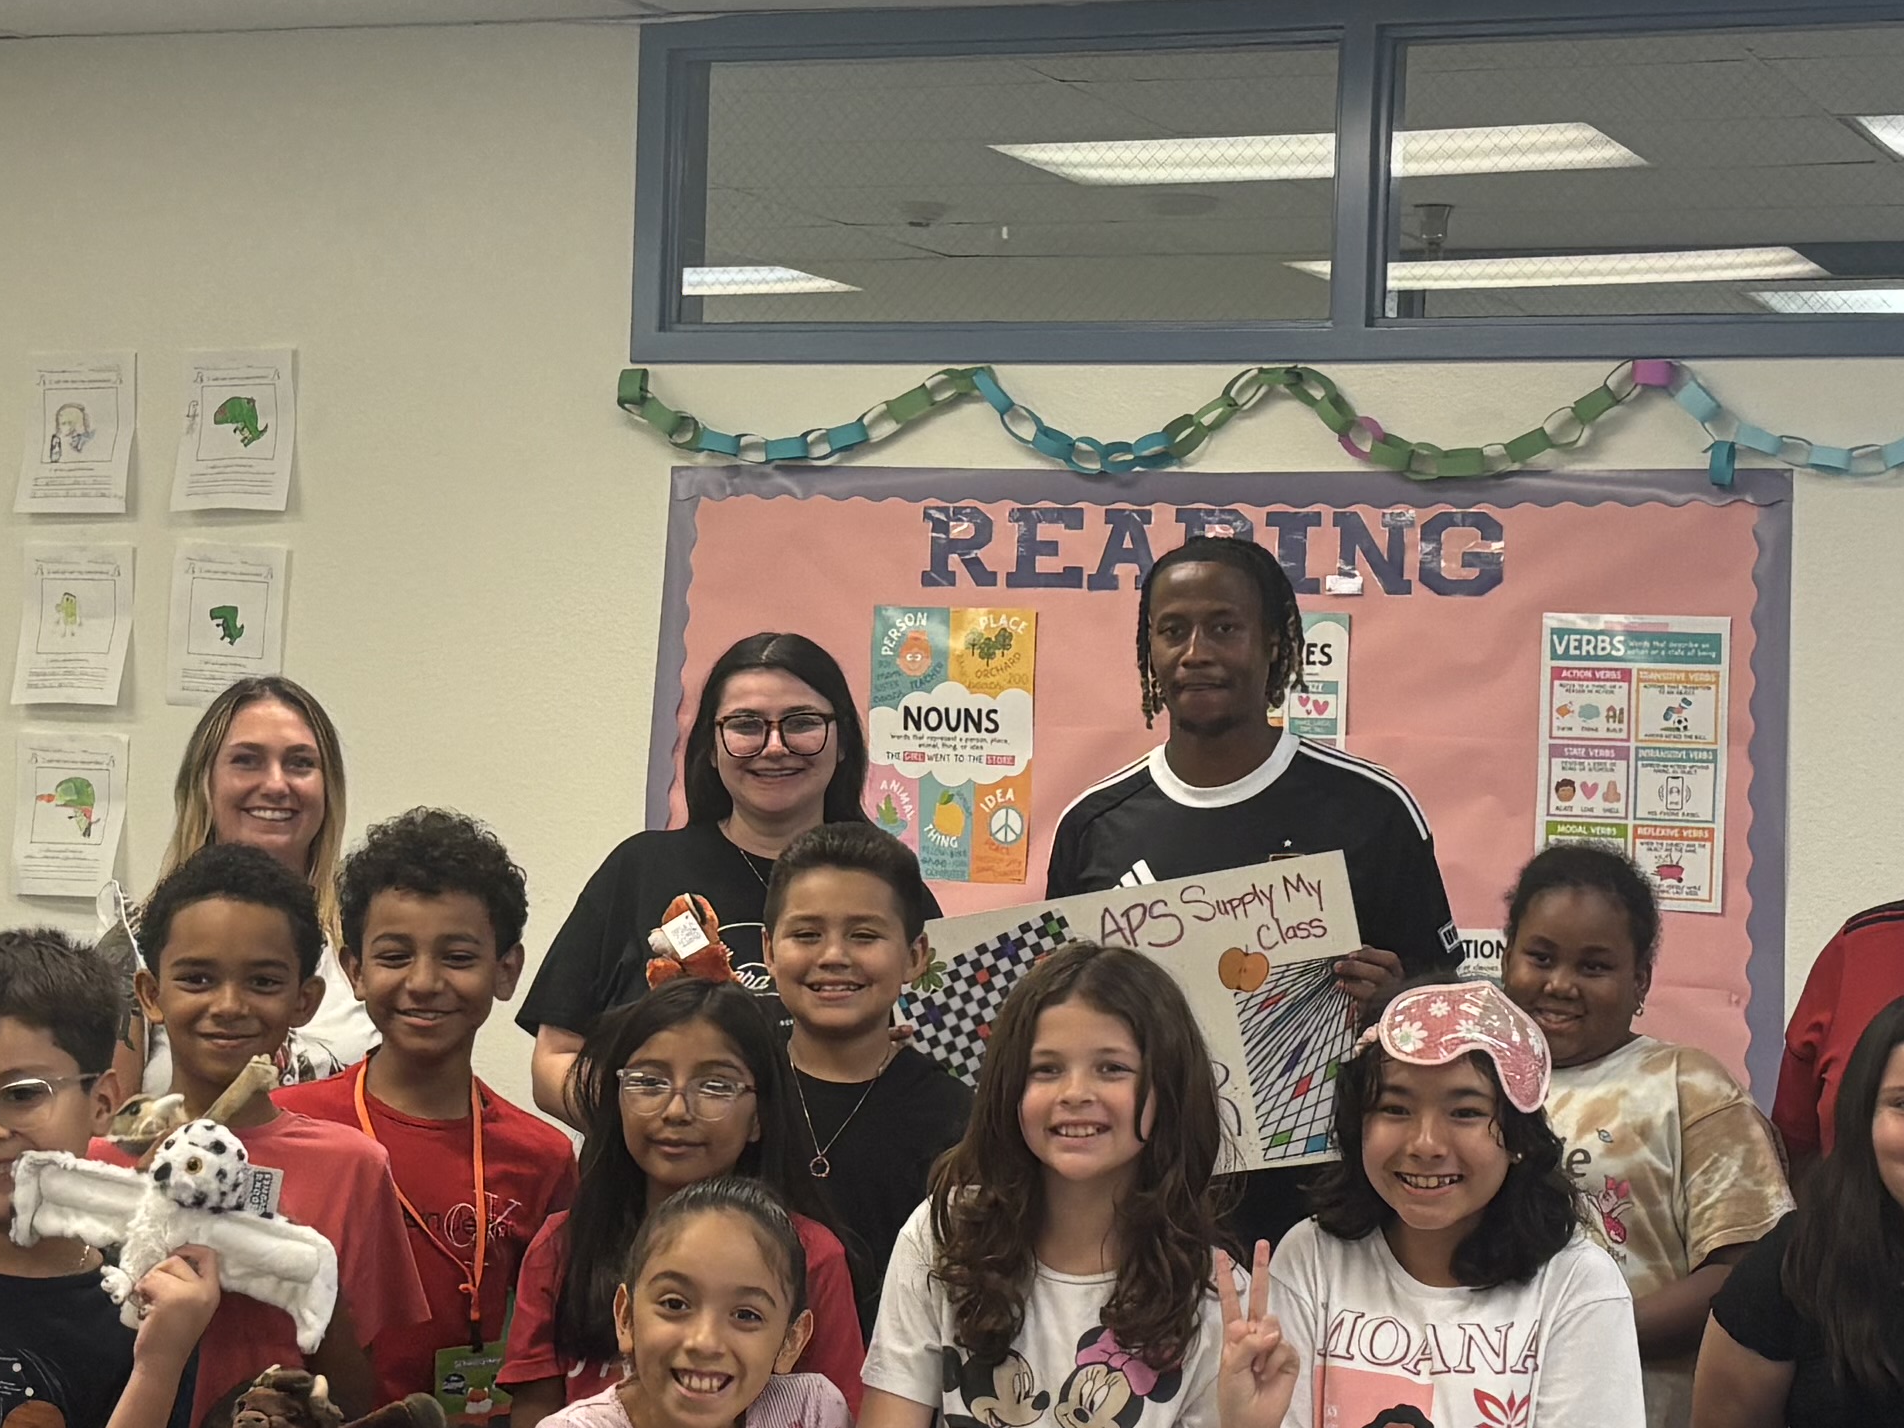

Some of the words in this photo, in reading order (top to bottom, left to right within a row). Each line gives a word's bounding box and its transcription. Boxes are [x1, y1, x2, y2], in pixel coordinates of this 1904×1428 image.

[880, 612, 928, 656] PERSON
[979, 613, 1028, 634] PLACE
[1553, 634, 1626, 657] VERBS
[1561, 669, 1592, 679] ACTION
[1594, 669, 1622, 679] VERBS
[1688, 672, 1715, 682] VERBS
[903, 705, 1000, 734] NOUNS
[886, 751, 901, 760] THE
[927, 753, 951, 763] WENT
[954, 755, 965, 763] TO
[967, 755, 984, 764] THE
[1564, 747, 1585, 757] STATE
[1587, 748, 1616, 758] VERBS
[1690, 751, 1713, 760] VERBS
[880, 779, 915, 821] ANIMAL
[979, 787, 1016, 813] IDEA
[923, 823, 959, 849] THING
[1557, 824, 1588, 834] MODAL
[1590, 826, 1617, 835] VERBS
[1682, 829, 1709, 838] VERBS
[1100, 899, 1184, 948] APS
[1180, 883, 1274, 922] Supply
[1283, 873, 1322, 911] My
[1257, 918, 1328, 950] Class
[1464, 938, 1505, 961] TION
[1317, 1309, 1541, 1375] MOANA
